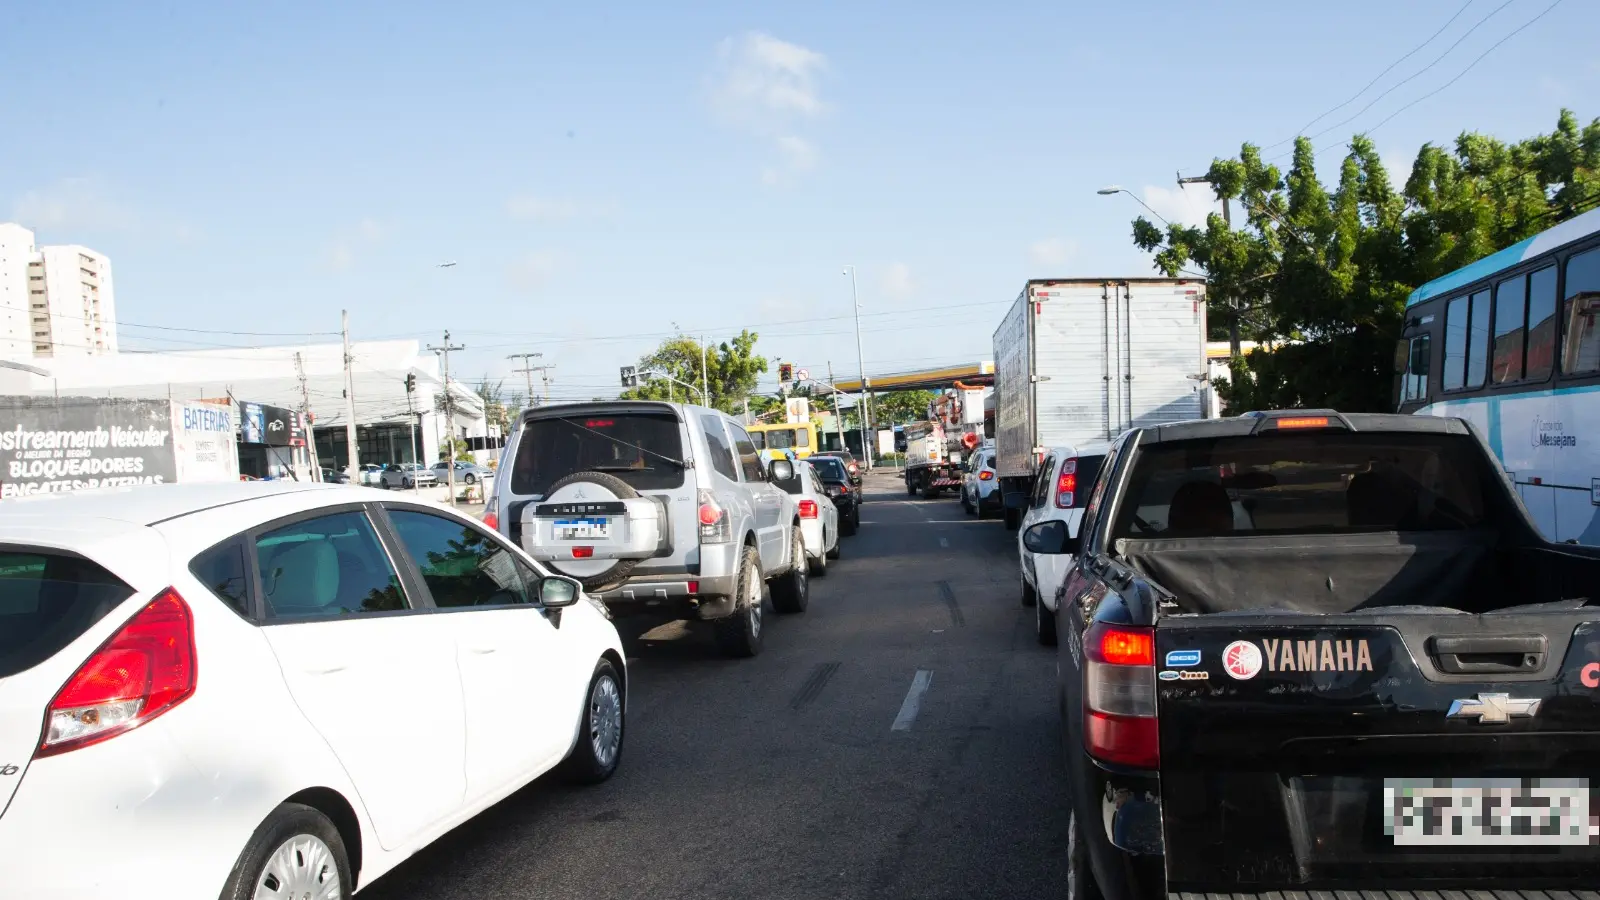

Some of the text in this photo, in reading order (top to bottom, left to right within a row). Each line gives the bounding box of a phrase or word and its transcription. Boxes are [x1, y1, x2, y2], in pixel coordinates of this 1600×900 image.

[184, 407, 230, 432] BATERIAS
[9, 457, 144, 479] BLOQUEADORES
[1262, 639, 1373, 671] YAMAHA
